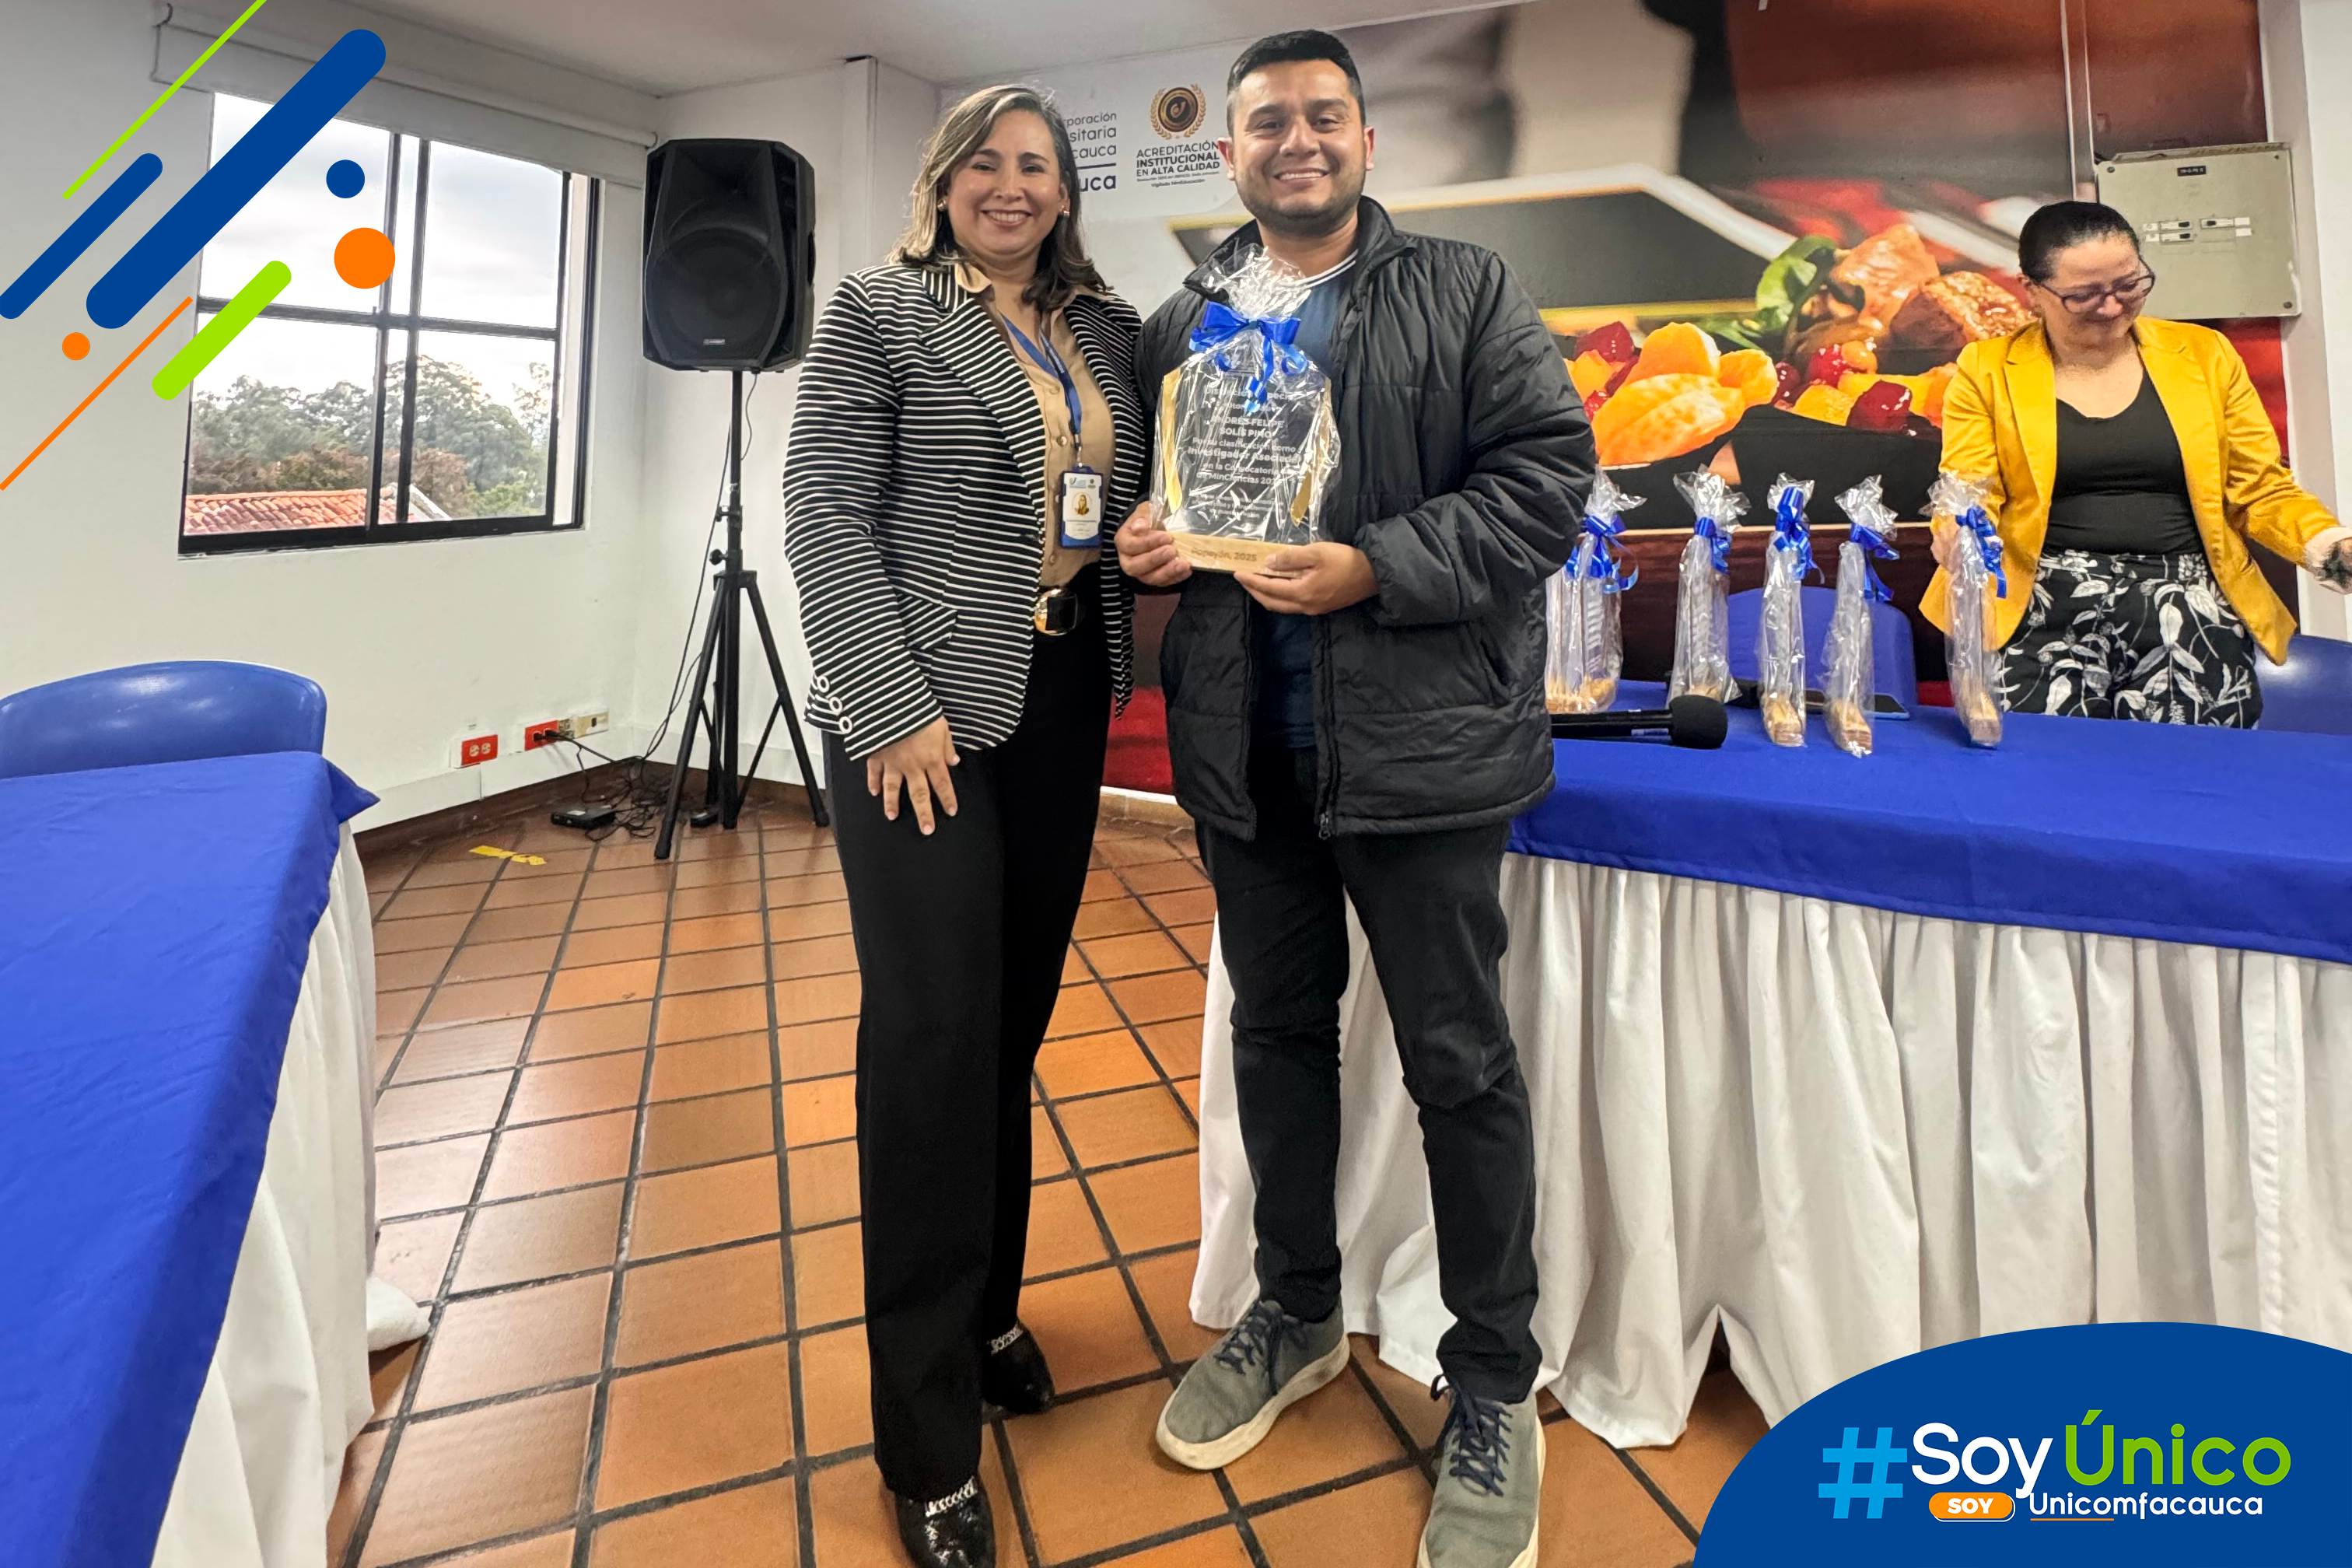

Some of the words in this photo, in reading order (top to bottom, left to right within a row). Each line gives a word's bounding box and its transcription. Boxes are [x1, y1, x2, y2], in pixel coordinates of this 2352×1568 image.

[1063, 112, 1117, 128] poración
[1069, 125, 1116, 142] sitaria
[1072, 145, 1116, 159] cauca
[1136, 140, 1219, 158] ACREDITACIÓN
[1136, 152, 1220, 168] INSTITUCIONAL
[1151, 166, 1174, 175] ALTA
[1177, 161, 1220, 173] CALIDAD
[1078, 175, 1116, 192] uca
[1234, 552, 1257, 562] 2025
